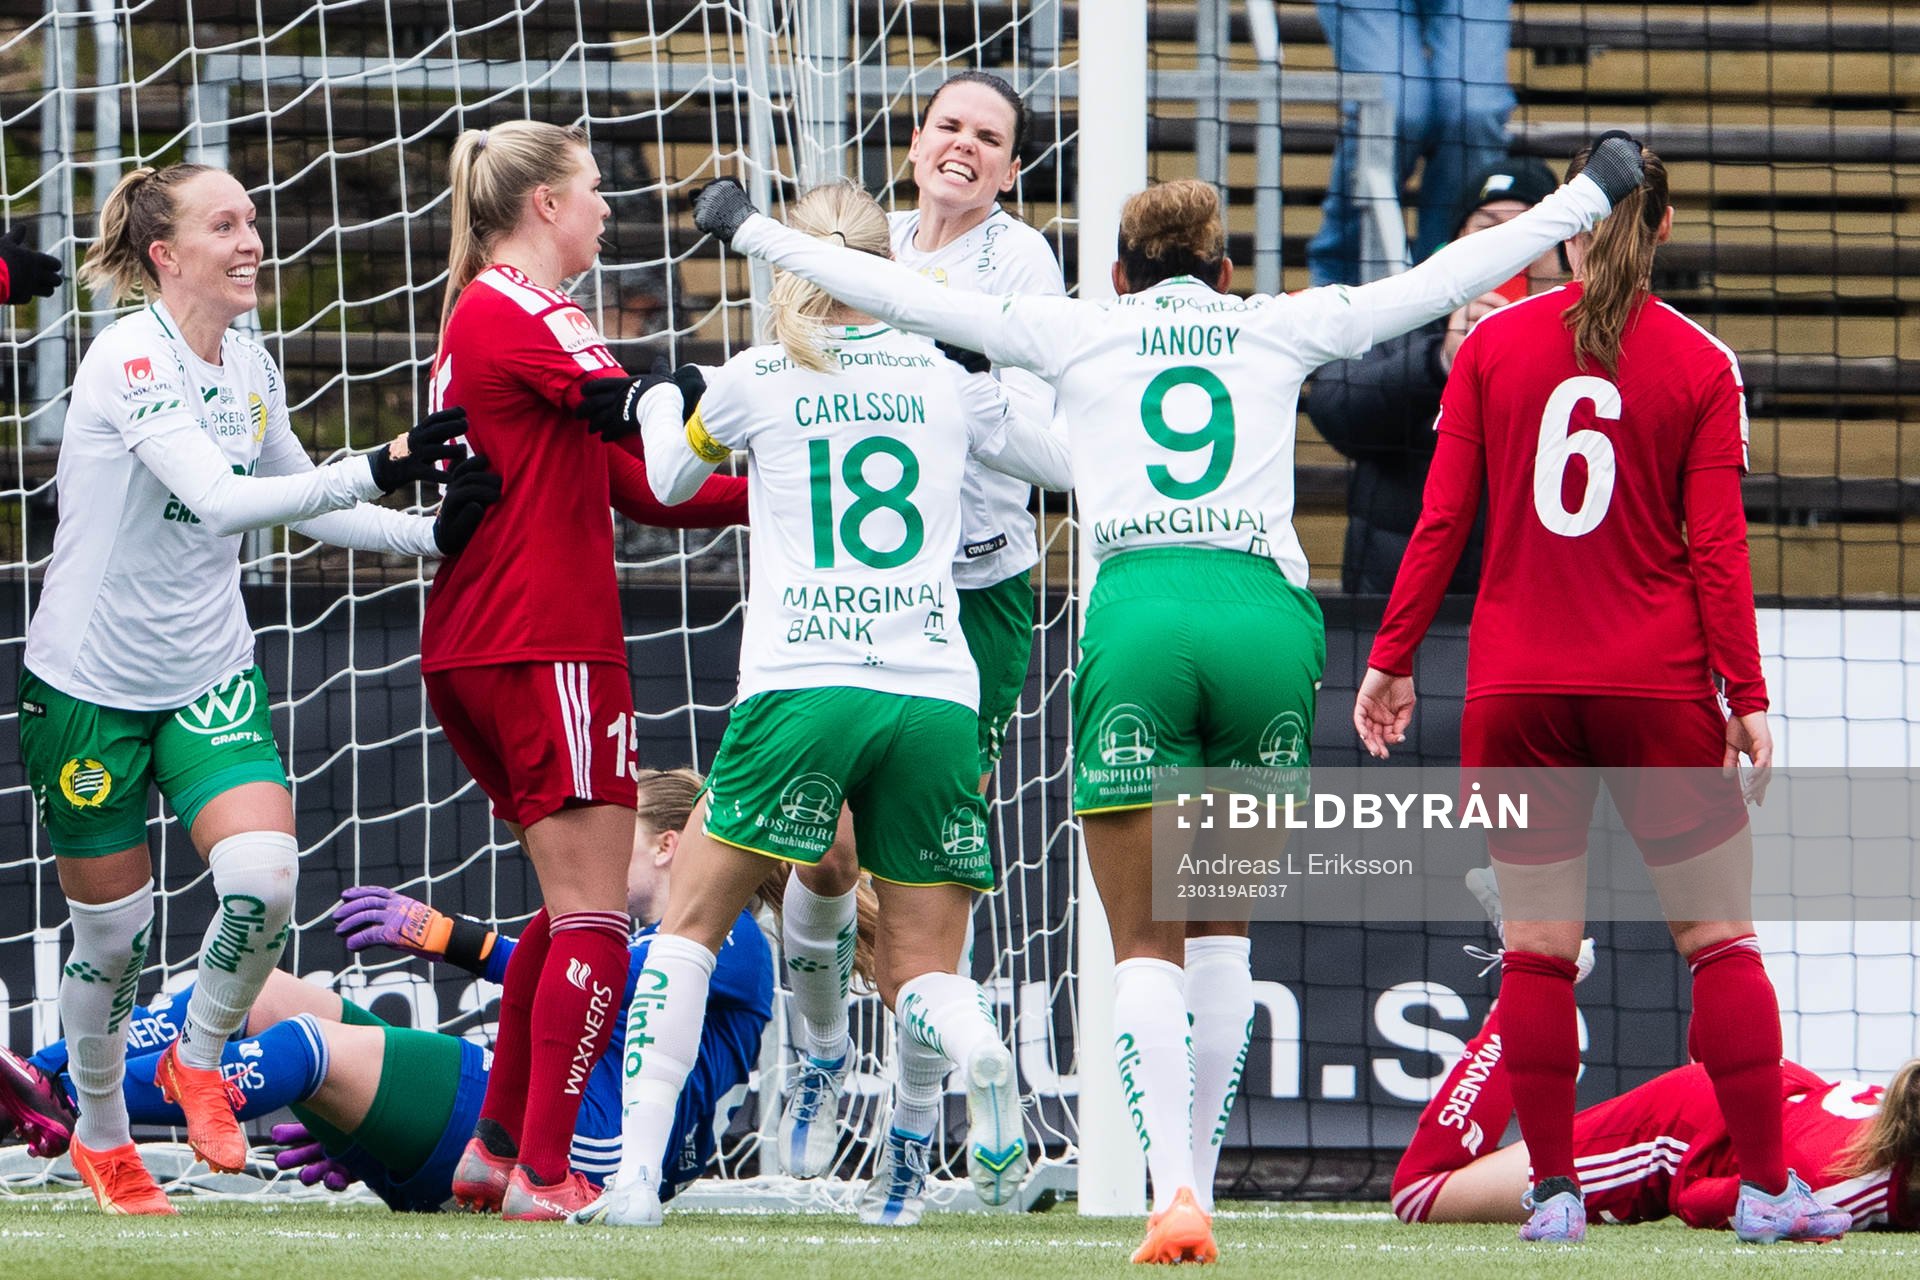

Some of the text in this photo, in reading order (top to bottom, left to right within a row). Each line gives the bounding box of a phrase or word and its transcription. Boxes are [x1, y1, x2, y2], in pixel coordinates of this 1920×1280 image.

[1136, 325, 1241, 357] JANOGY
[839, 350, 937, 371] pantbank
[795, 392, 926, 427] CARLSSON
[1140, 365, 1236, 501] 9
[1533, 375, 1622, 538] 6
[808, 435, 925, 570] 18
[1094, 506, 1268, 545] MARGINAL
[783, 581, 945, 614] MARGINAL
[787, 614, 876, 646] BANK
[210, 732, 254, 747] CRAFT
[563, 980, 613, 1096] WIXNERS
[1437, 1032, 1504, 1131] WIXNERS
